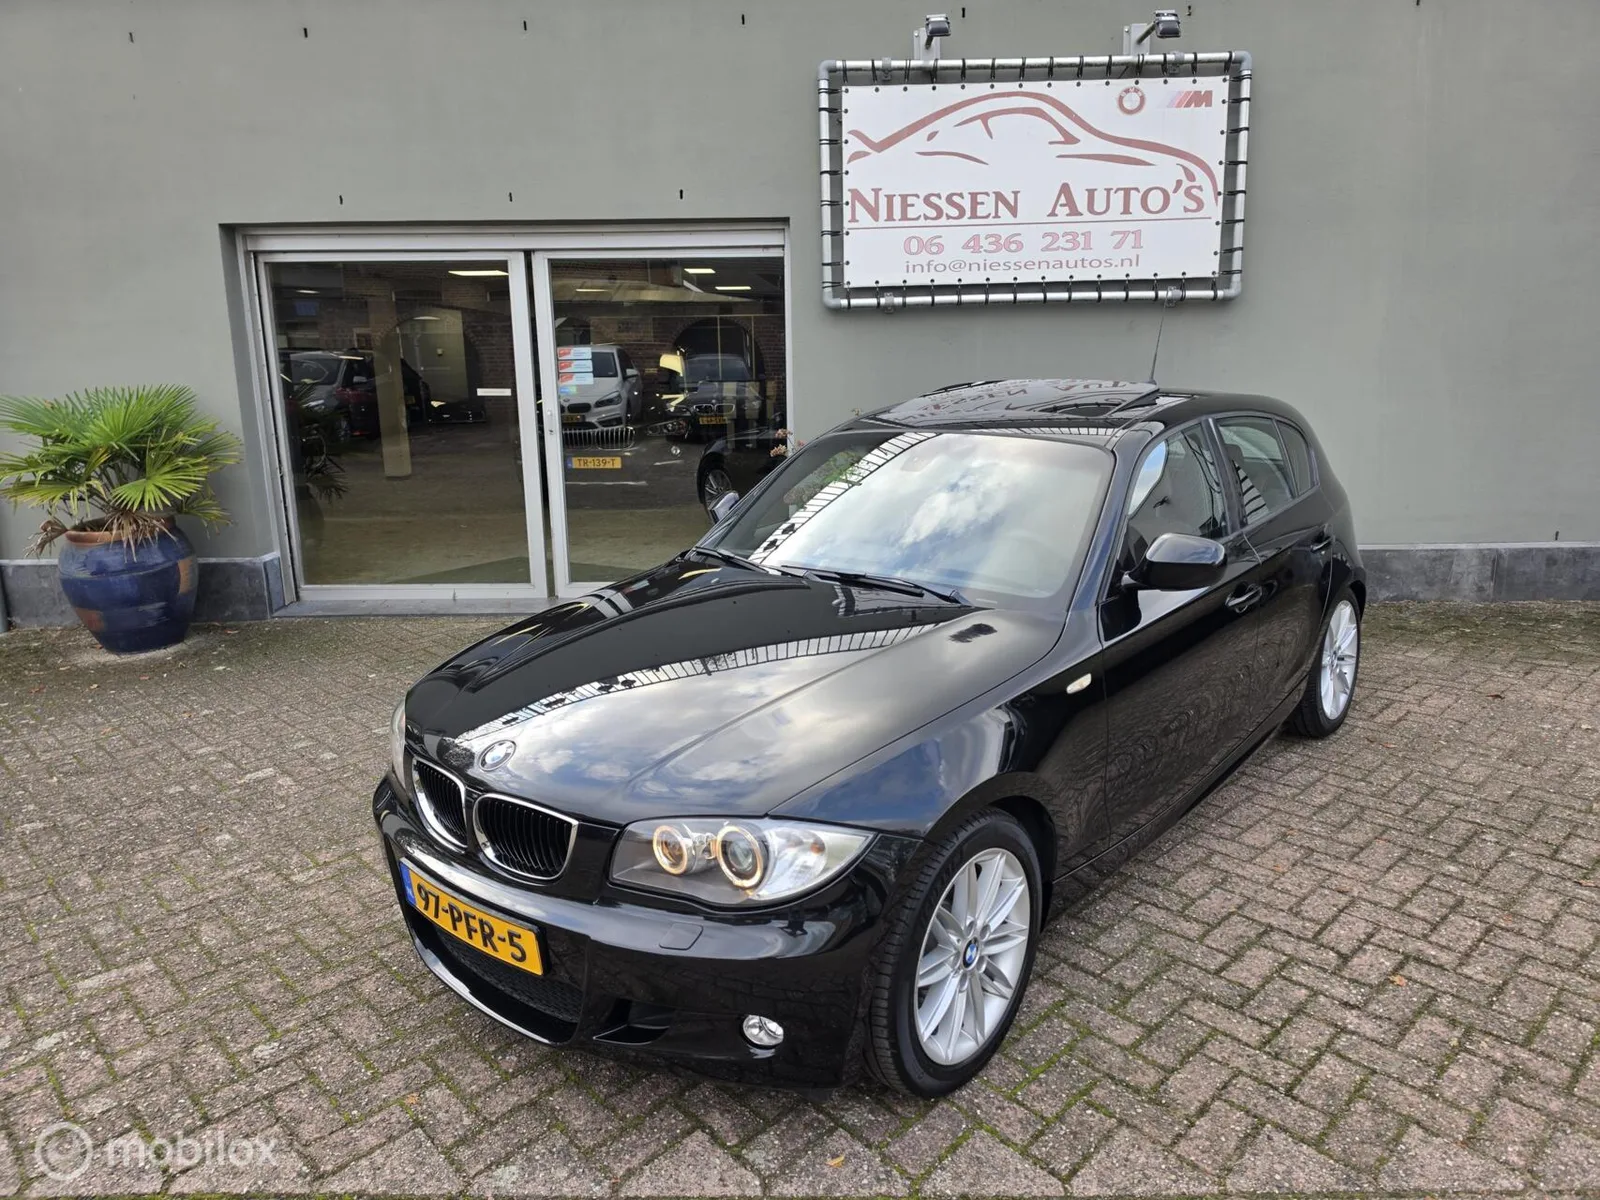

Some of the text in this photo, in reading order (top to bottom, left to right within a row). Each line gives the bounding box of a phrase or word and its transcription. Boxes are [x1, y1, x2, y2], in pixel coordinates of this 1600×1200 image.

[848, 187, 1021, 223] NIESSEN
[903, 229, 1144, 256] 06 436 231 71
[905, 254, 1140, 274] info@niessenautos.nl
[576, 458, 616, 467] TR-139-T
[416, 883, 527, 963] 97-PFR-5
